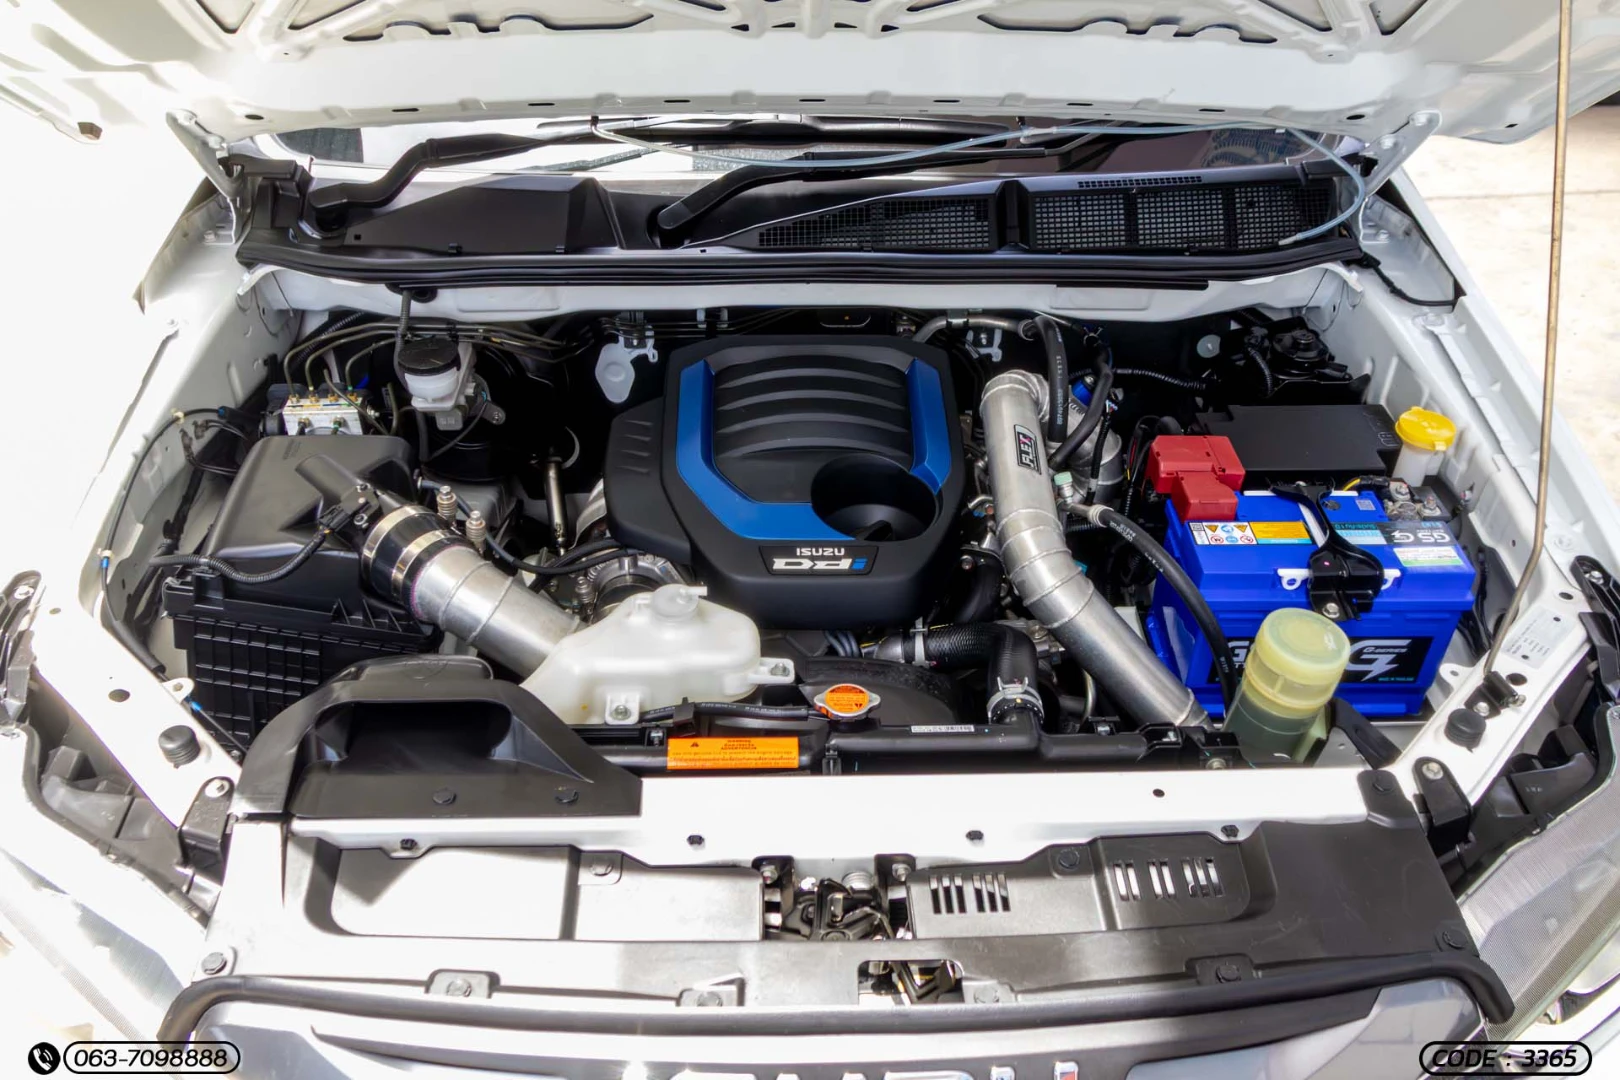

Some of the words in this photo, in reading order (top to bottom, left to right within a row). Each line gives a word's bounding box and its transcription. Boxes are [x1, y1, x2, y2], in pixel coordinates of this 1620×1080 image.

[1019, 433, 1034, 468] FLEX
[1417, 532, 1451, 543] GS
[796, 547, 845, 556] ISUZU
